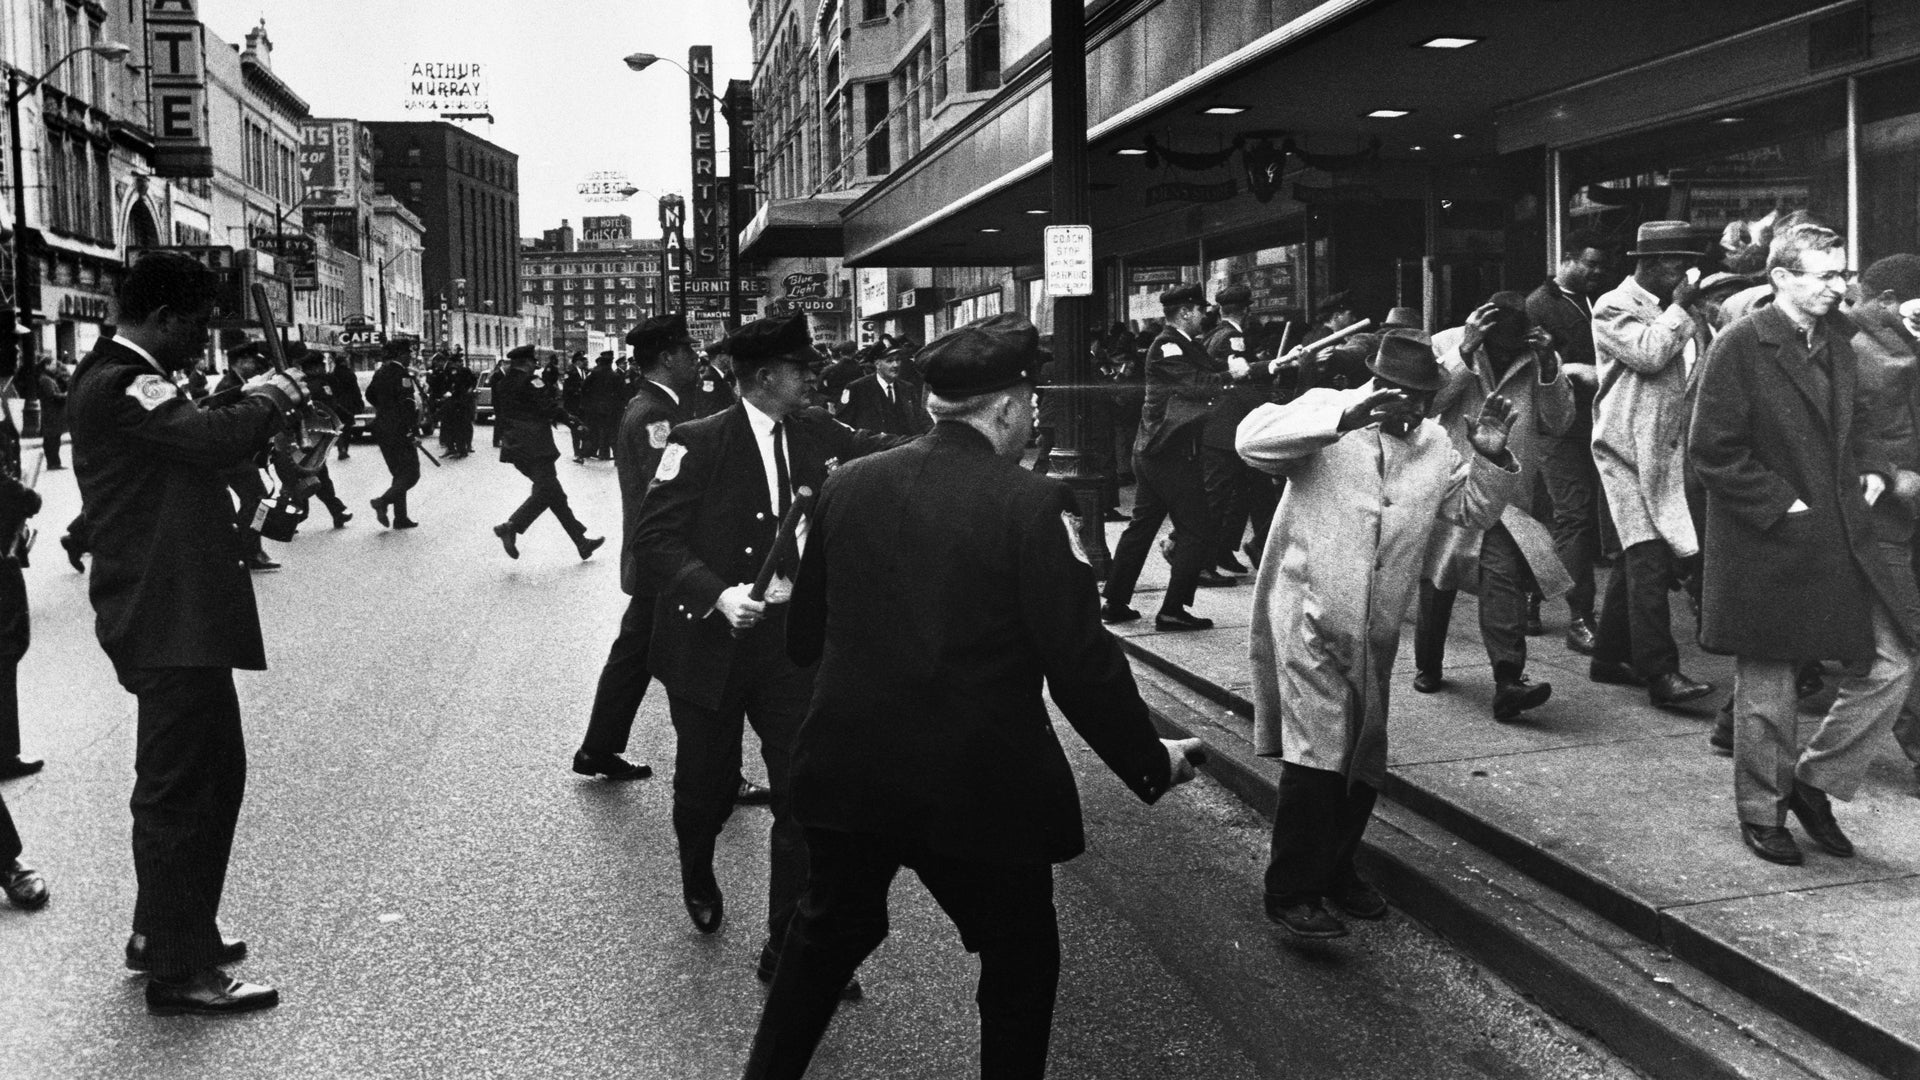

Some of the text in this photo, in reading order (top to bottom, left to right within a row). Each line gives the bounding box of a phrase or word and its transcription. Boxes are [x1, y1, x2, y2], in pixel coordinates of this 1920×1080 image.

[153, 0, 194, 136] TE
[412, 62, 480, 79] ARTHUR
[412, 82, 480, 96] MURRAY
[693, 57, 715, 263] HAVERTY'S
[600, 218, 626, 228] HOTEL
[1053, 233, 1084, 244] COACH
[1057, 246, 1080, 256] STOP
[789, 274, 813, 286] Blue
[1050, 270, 1087, 280] PARKING
[684, 280, 758, 293] FURNITRE
[786, 282, 820, 298] Light
[788, 301, 834, 310] STUDIO
[441, 293, 449, 342] LOANS
[339, 331, 381, 344] CAFE
